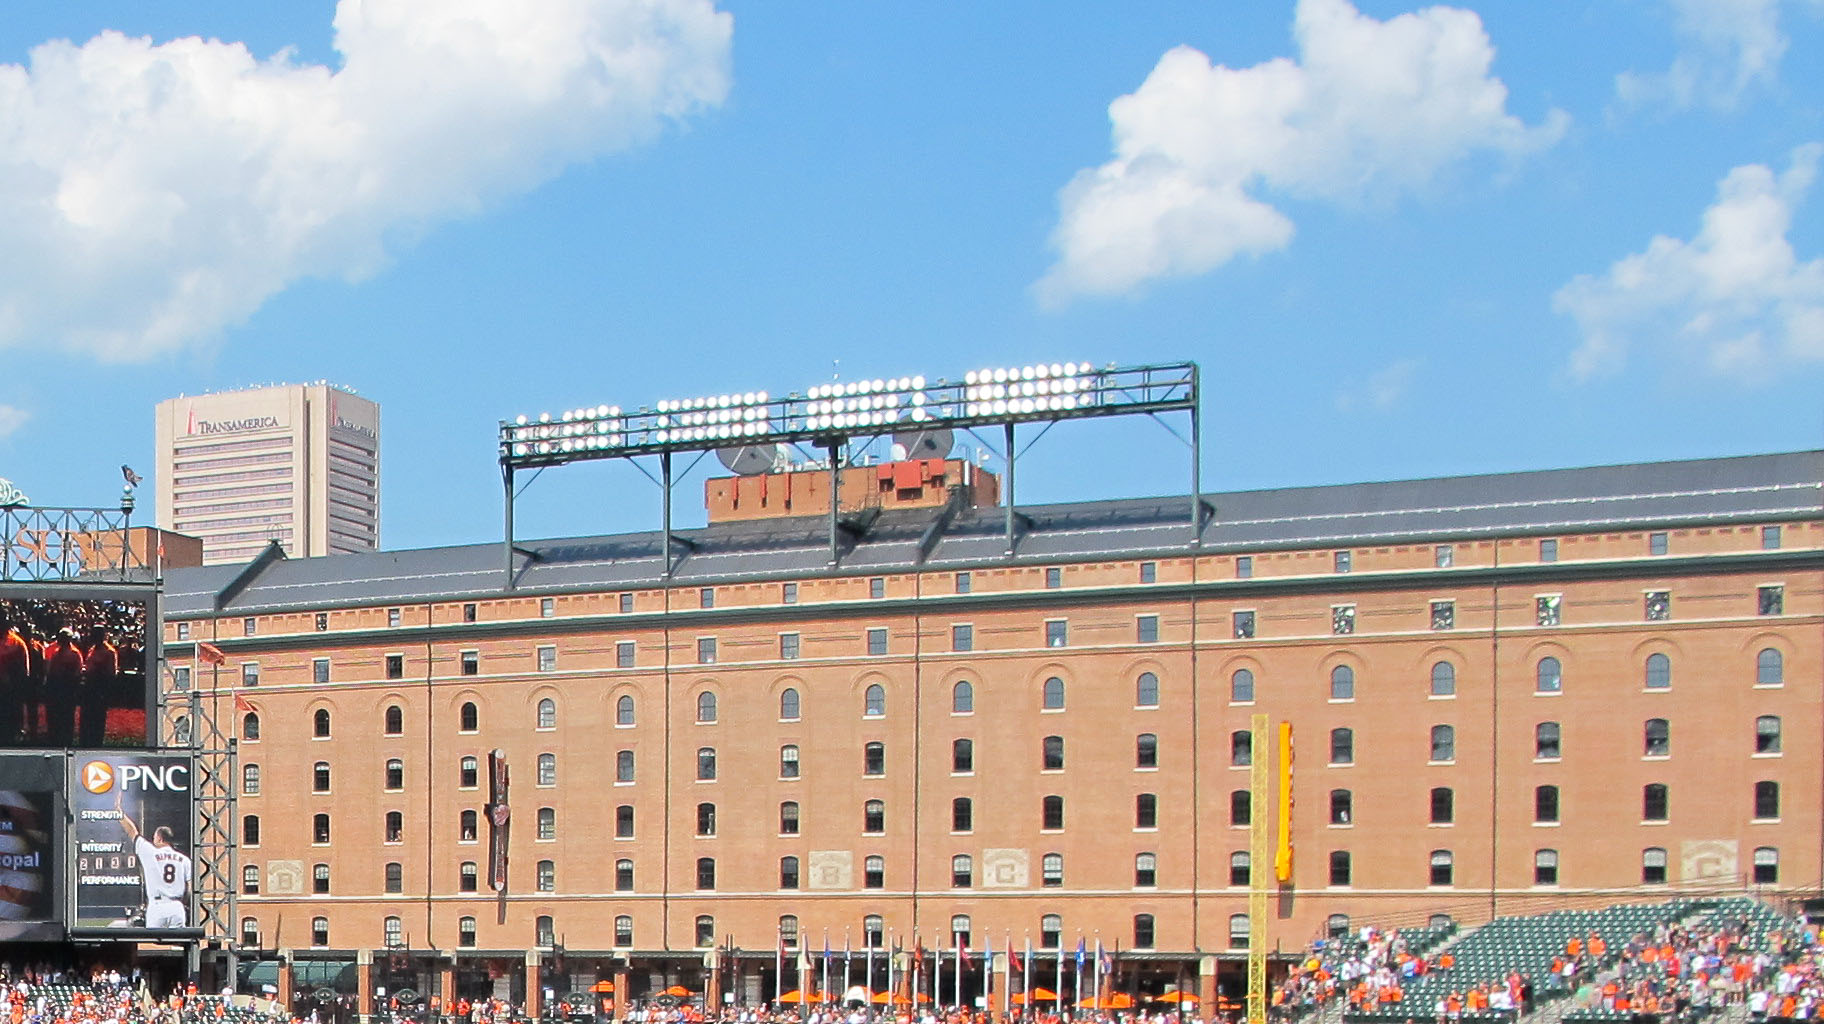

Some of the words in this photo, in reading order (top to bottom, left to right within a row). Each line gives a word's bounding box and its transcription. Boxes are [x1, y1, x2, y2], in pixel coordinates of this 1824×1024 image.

[198, 416, 278, 434] TRANSAMERICA
[16, 526, 97, 563] SUN
[117, 765, 188, 791] PNC
[81, 810, 123, 820] STRENGTH
[81, 842, 122, 852] INTEGRITY
[81, 876, 140, 885] PERFORMANCE
[163, 864, 176, 883] 8
